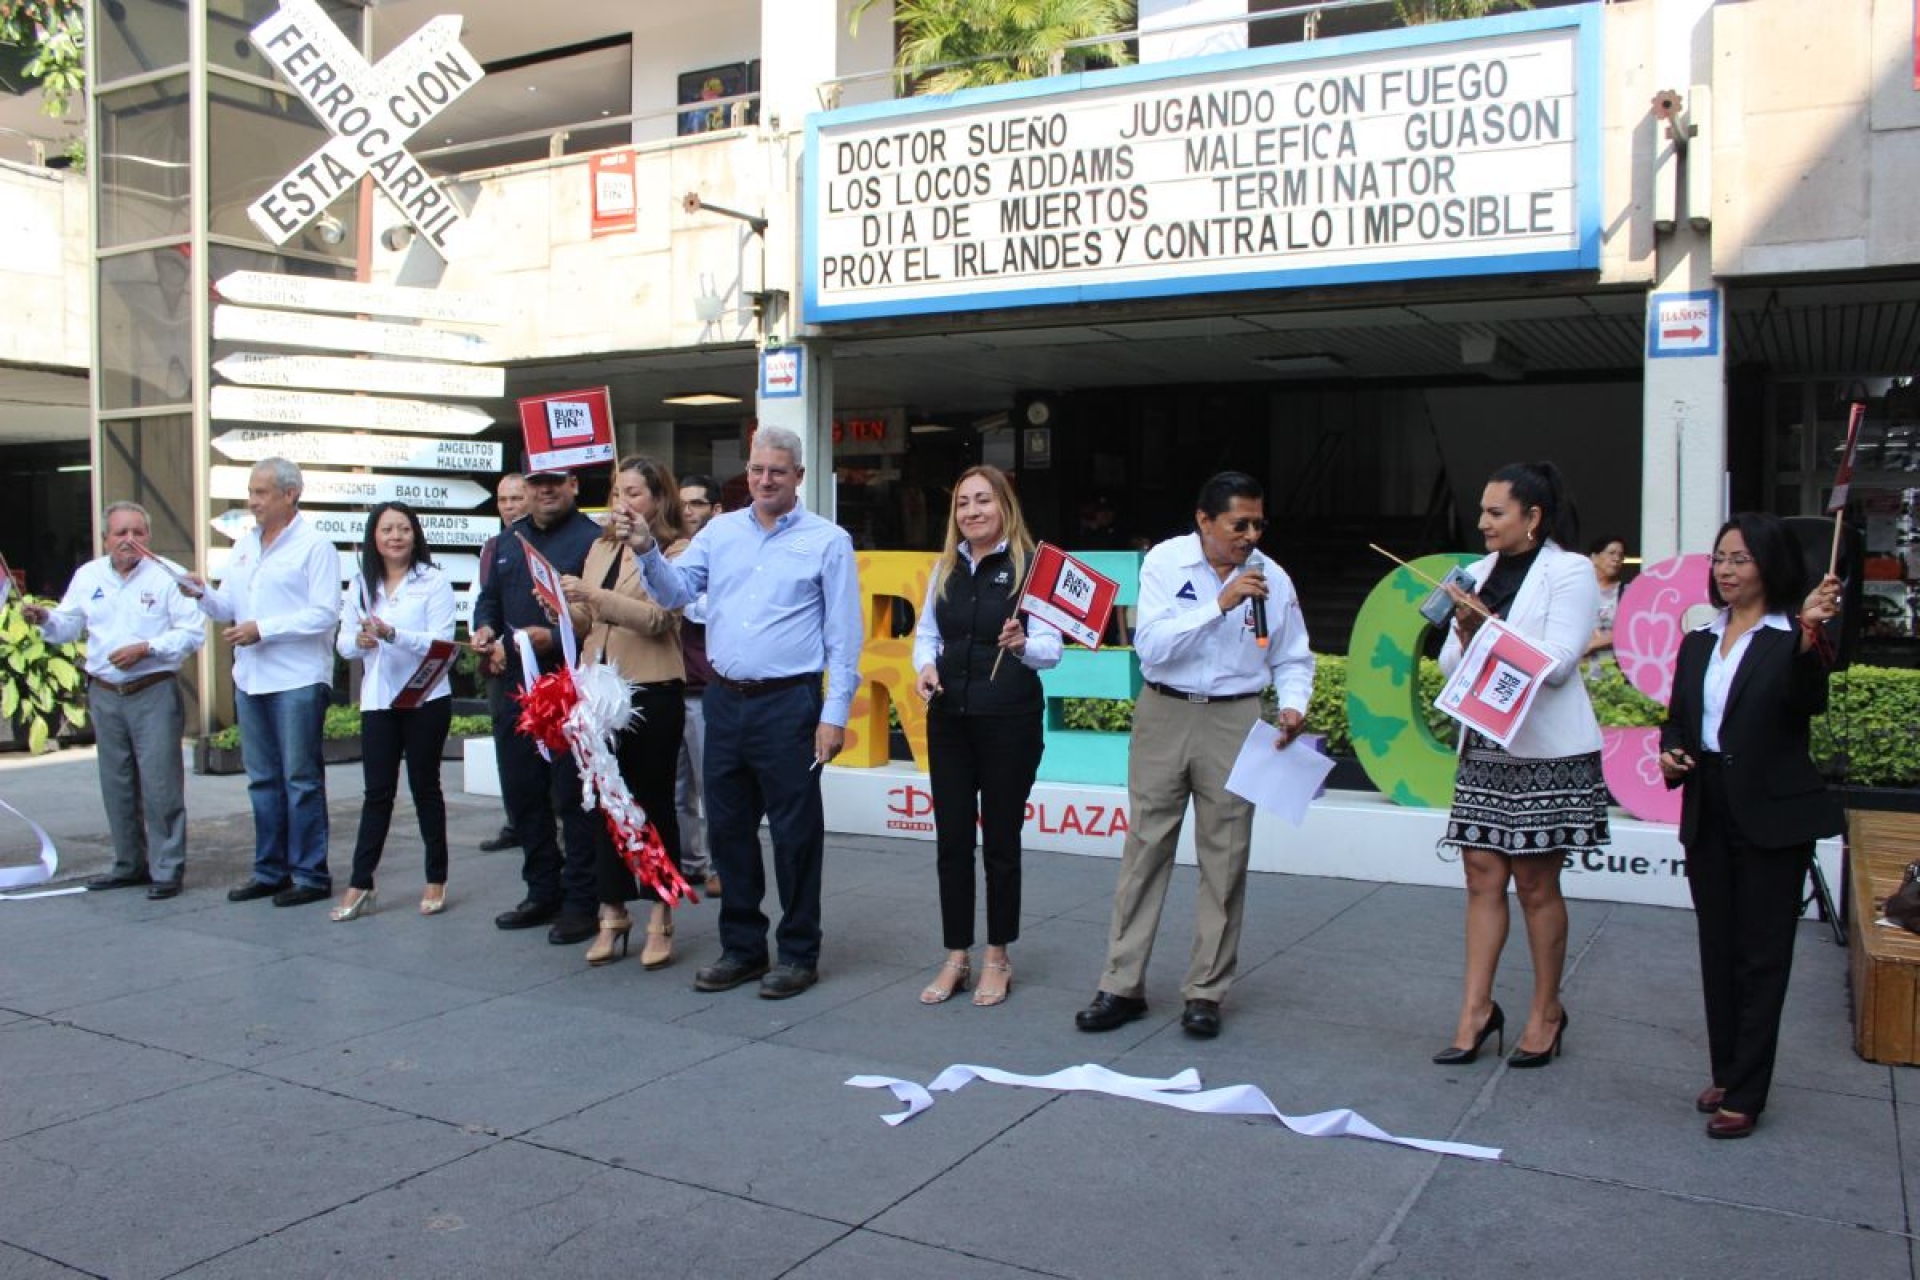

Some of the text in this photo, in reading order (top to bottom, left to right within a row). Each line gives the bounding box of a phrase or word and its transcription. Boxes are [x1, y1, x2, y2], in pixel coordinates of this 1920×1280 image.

[838, 60, 1507, 174] DOCTOR SUEÑO JUGANDO CON FUEGO
[266, 24, 459, 248] FERROCARRIL
[828, 100, 1559, 213] LOS LOCOS ADDAMS MALEFICA GUASON
[863, 156, 1455, 247] DIA DE MUERTOS TERMINATOR
[823, 251, 894, 289] PROX
[904, 247, 940, 283] EL
[954, 231, 1102, 278] IRLANDES
[1114, 227, 1131, 263] Y
[1348, 191, 1553, 246] IMPOSIBLE
[554, 408, 584, 419] BUEN
[555, 417, 578, 430] FIN
[437, 442, 494, 456] ANGELITOS
[436, 456, 493, 470] HALLMARK
[396, 485, 449, 499] BAO LOK
[315, 520, 347, 533] COOL
[1062, 578, 1082, 598] FIN
[1066, 568, 1090, 593] BUEN
